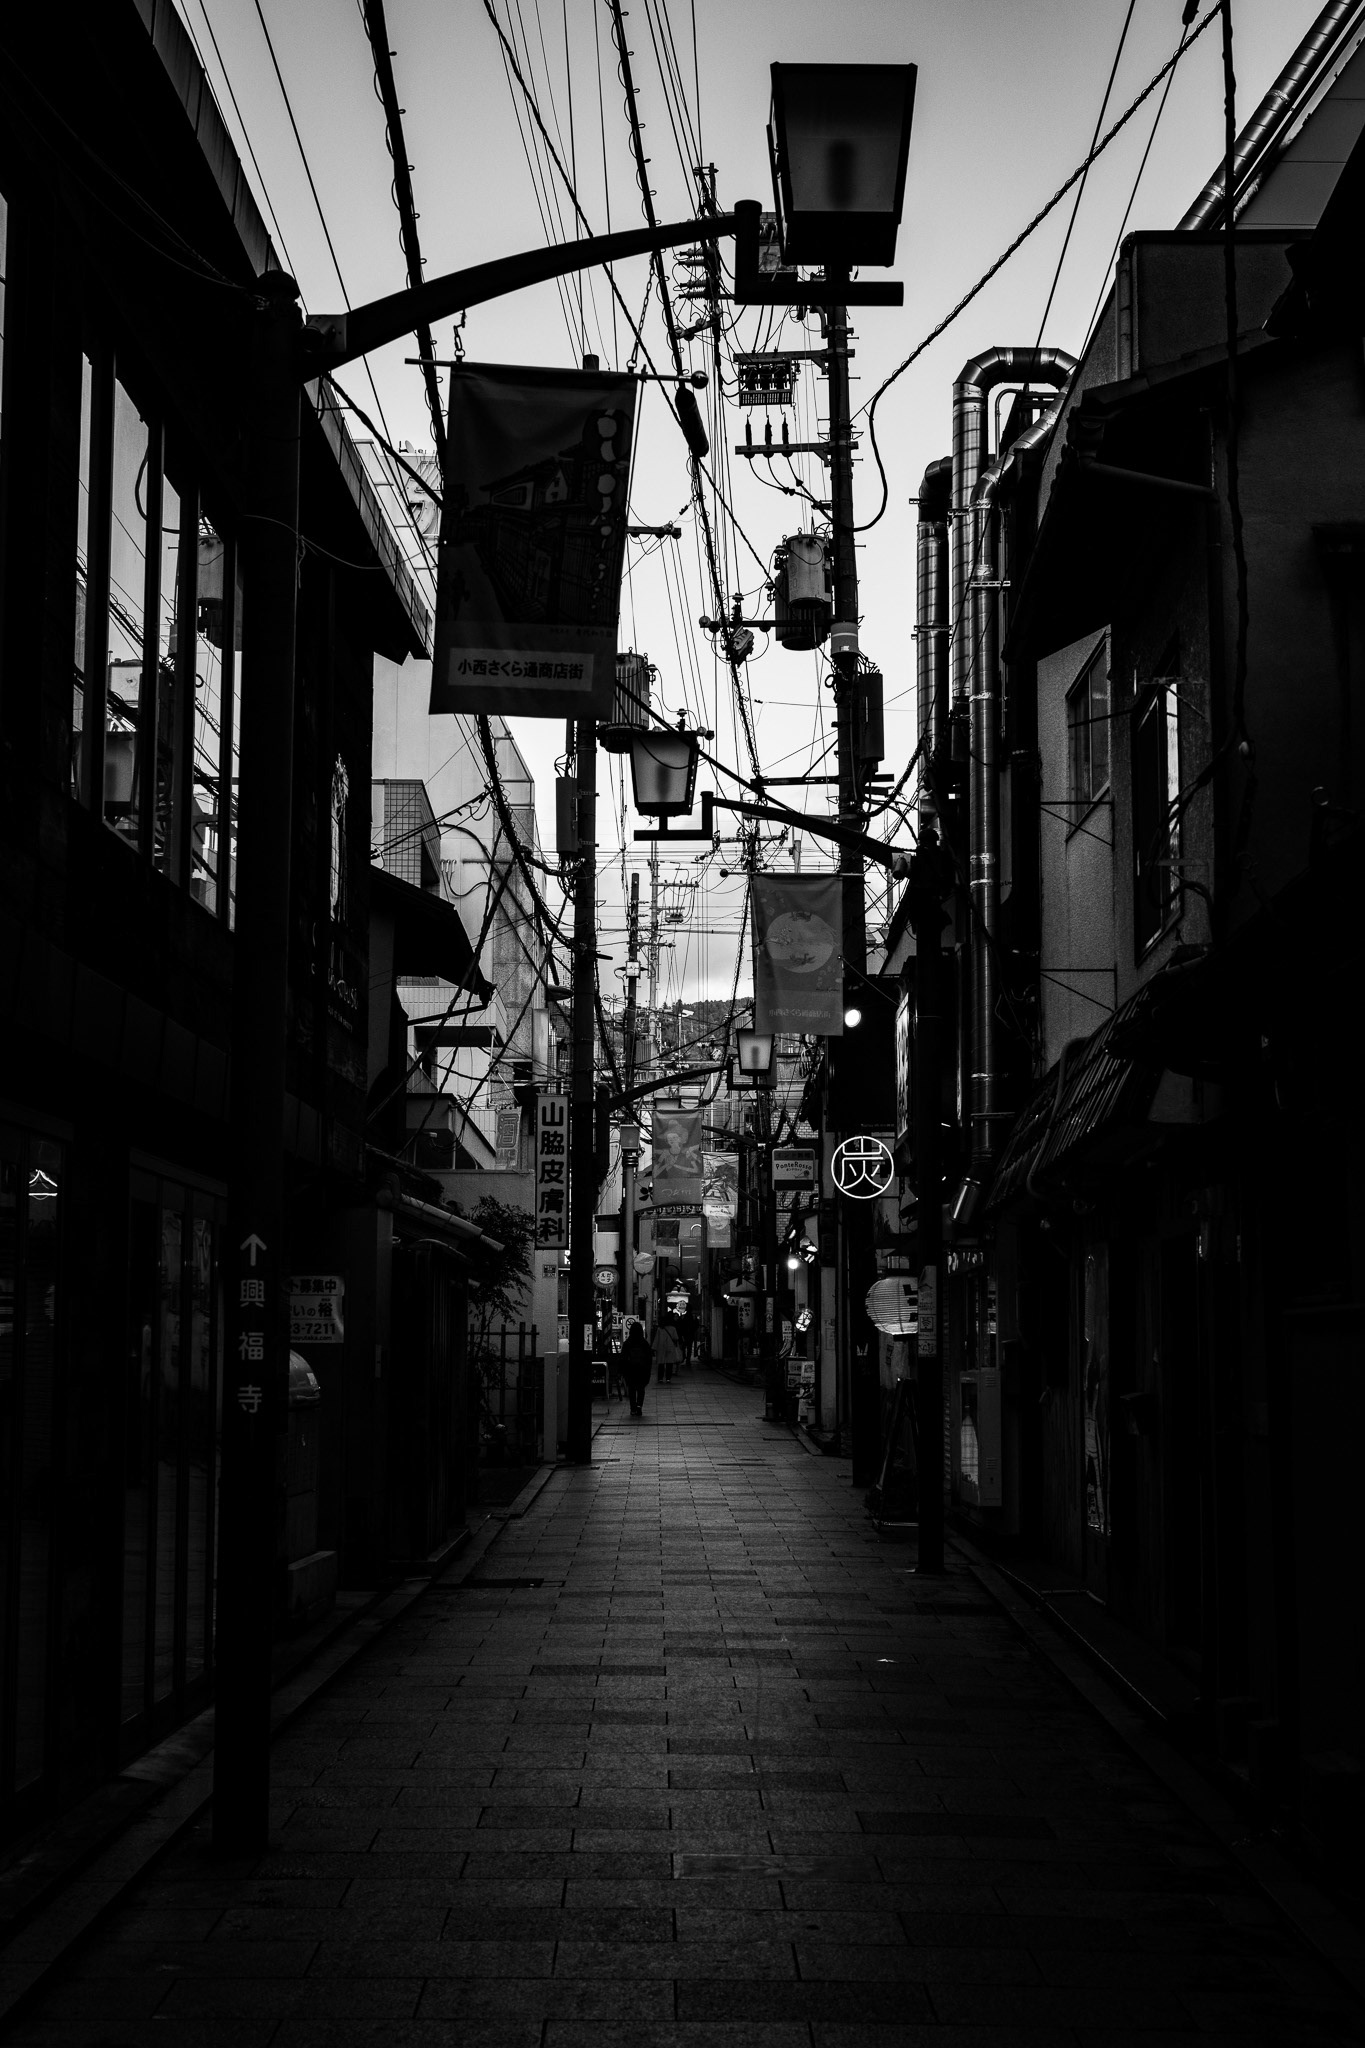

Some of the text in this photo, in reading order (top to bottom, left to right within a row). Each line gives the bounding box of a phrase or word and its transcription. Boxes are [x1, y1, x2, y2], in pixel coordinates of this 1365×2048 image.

[458, 658, 584, 680] 小西さくら通商店街
[539, 1102, 565, 1242] 山脇皮膚科
[841, 1138, 885, 1190] 炭
[290, 1278, 337, 1293] ト募集中
[291, 1302, 333, 1317] いの裕
[291, 1323, 336, 1334] 3-7211
[236, 1279, 266, 1414] 興福寺
